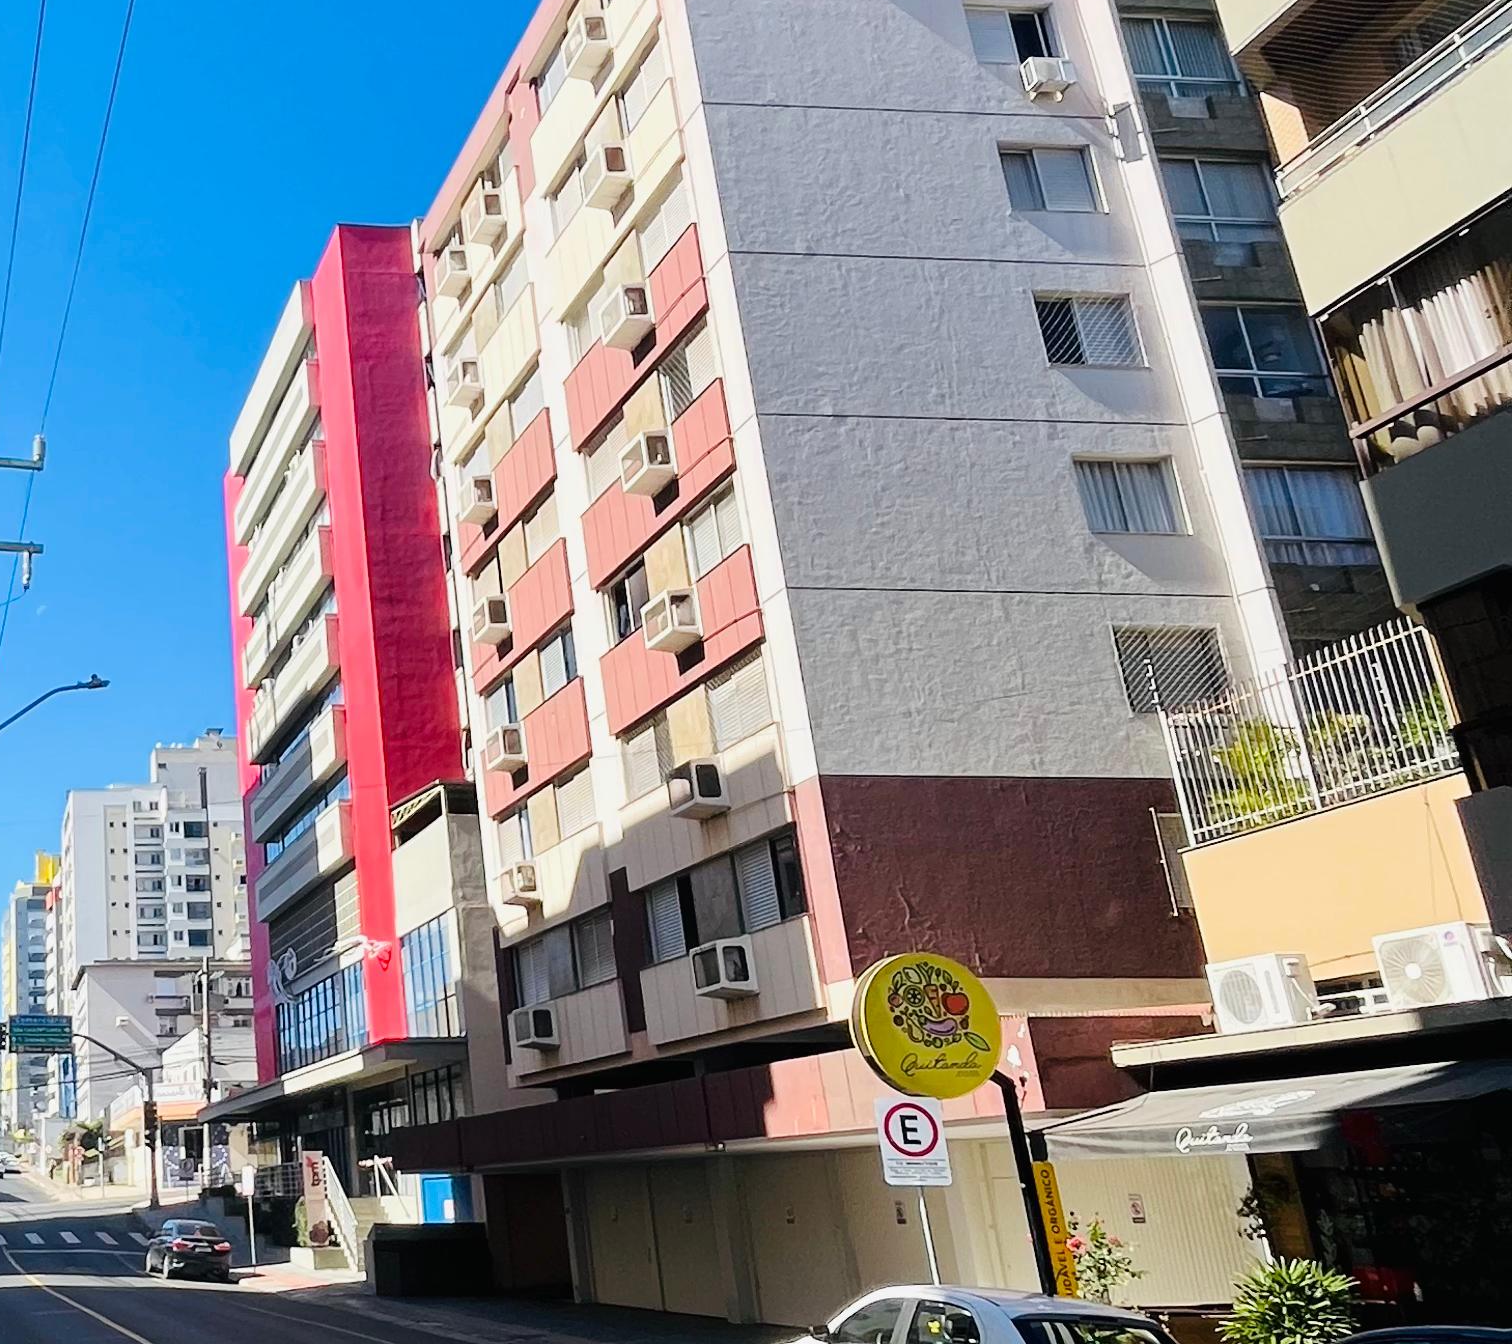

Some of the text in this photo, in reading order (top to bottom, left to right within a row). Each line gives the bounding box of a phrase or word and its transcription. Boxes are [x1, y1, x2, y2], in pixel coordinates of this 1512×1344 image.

[901, 1052, 982, 1076] Quitanda
[899, 1115, 922, 1145] E
[1175, 1122, 1254, 1154] Quitanda
[1056, 1249, 1074, 1297] UDÁVEL
